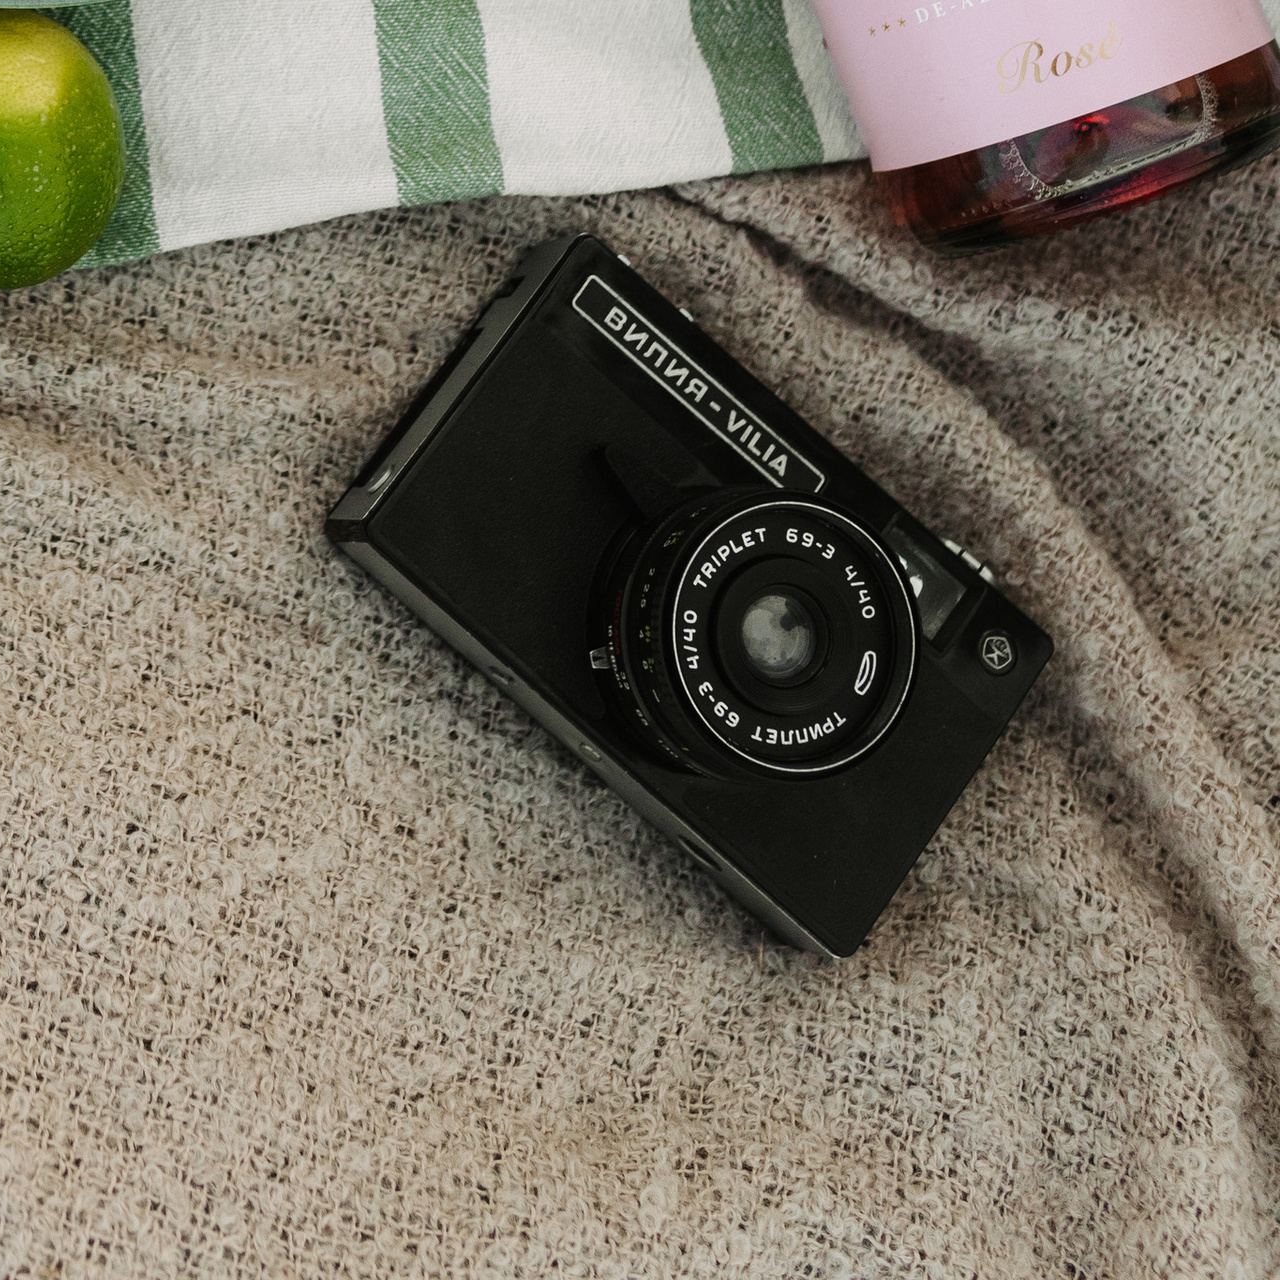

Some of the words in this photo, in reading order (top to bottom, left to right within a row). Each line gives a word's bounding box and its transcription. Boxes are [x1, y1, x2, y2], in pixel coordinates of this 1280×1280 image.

[996, 21, 1124, 95] Rosé
[693, 528, 767, 588] TRIPLET
[785, 528, 836, 560] 69-3
[845, 566, 876, 619] 4/40
[683, 610, 700, 670] 4/40
[699, 682, 740, 727] 69-3
[751, 712, 847, 745] ТРИПЛЕТ
